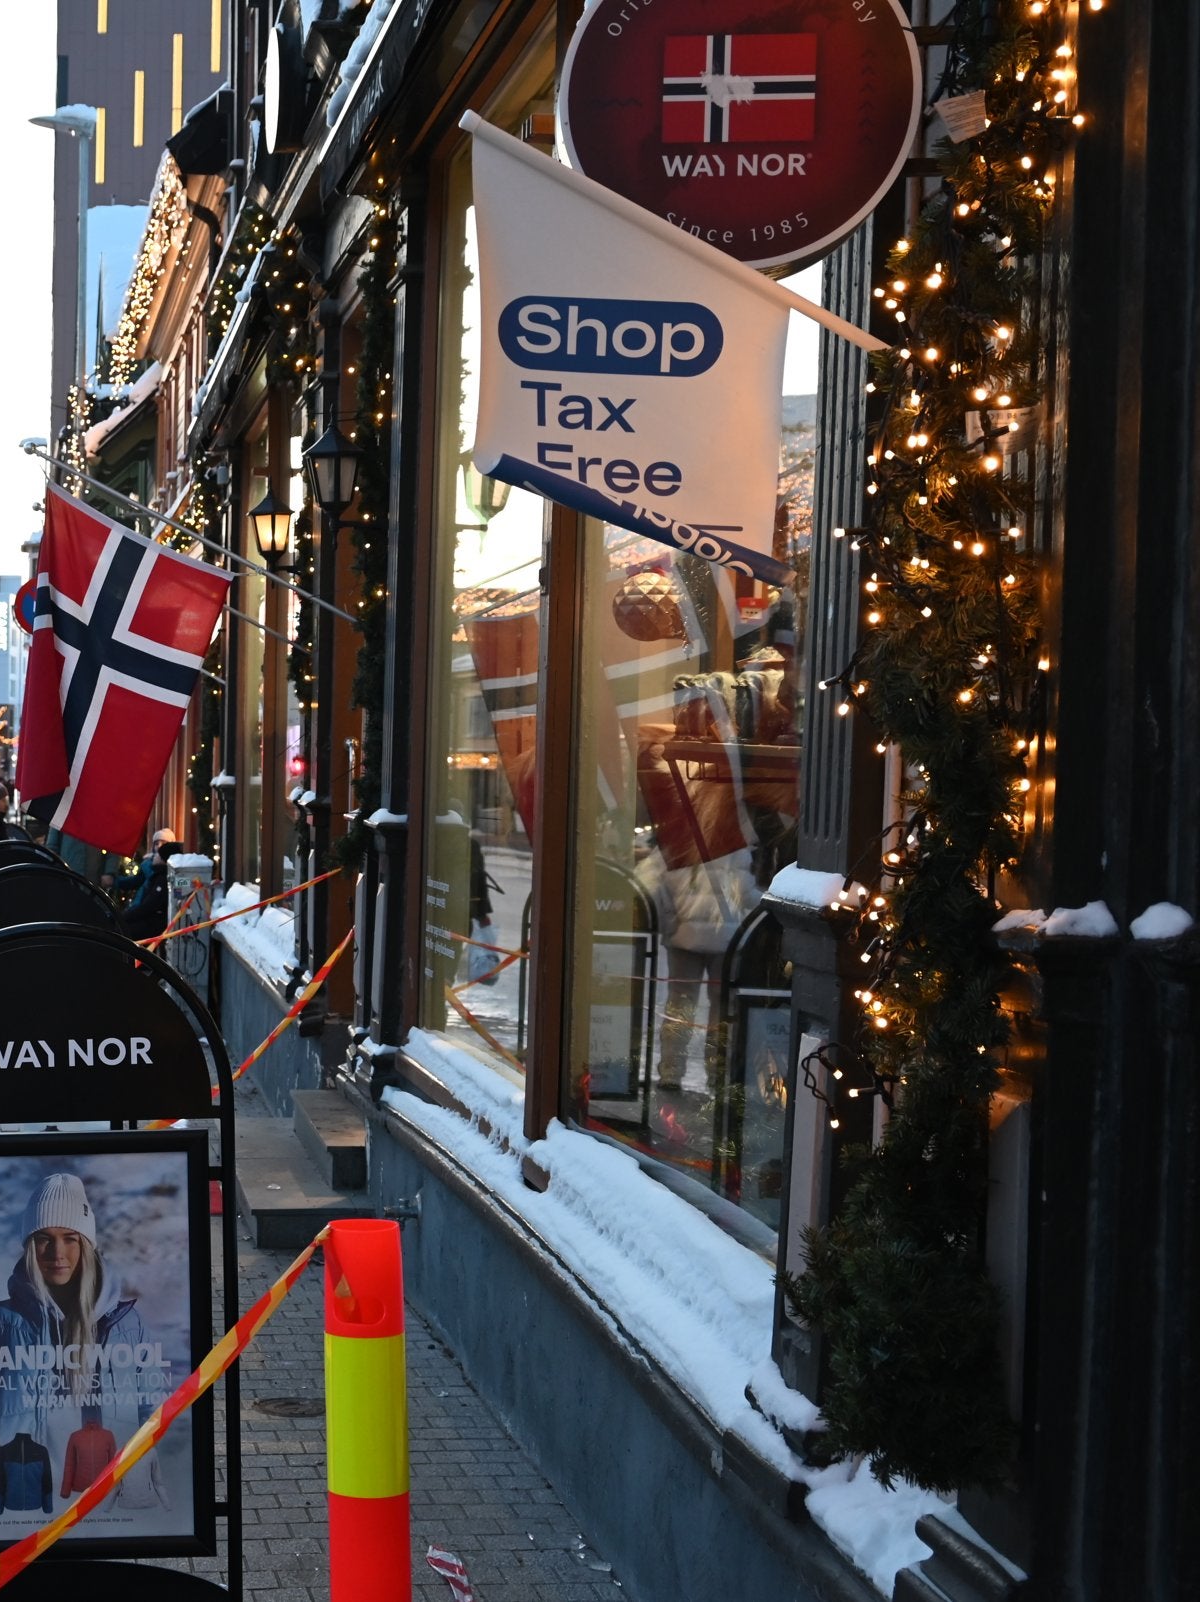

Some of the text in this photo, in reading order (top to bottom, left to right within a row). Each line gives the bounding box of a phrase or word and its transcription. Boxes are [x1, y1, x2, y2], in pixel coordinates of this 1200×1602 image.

[661, 152, 807, 178] WAY NOR
[666, 211, 809, 244] Since 1985
[516, 303, 706, 373] Shop
[520, 380, 638, 433] Tax
[536, 441, 683, 497] Free
[67, 1036, 154, 1067] NOR
[85, 1342, 172, 1369] WOOL
[19, 1373, 71, 1392] WOOL
[72, 1371, 173, 1390] INSULATION
[22, 1393, 69, 1409] WARM
